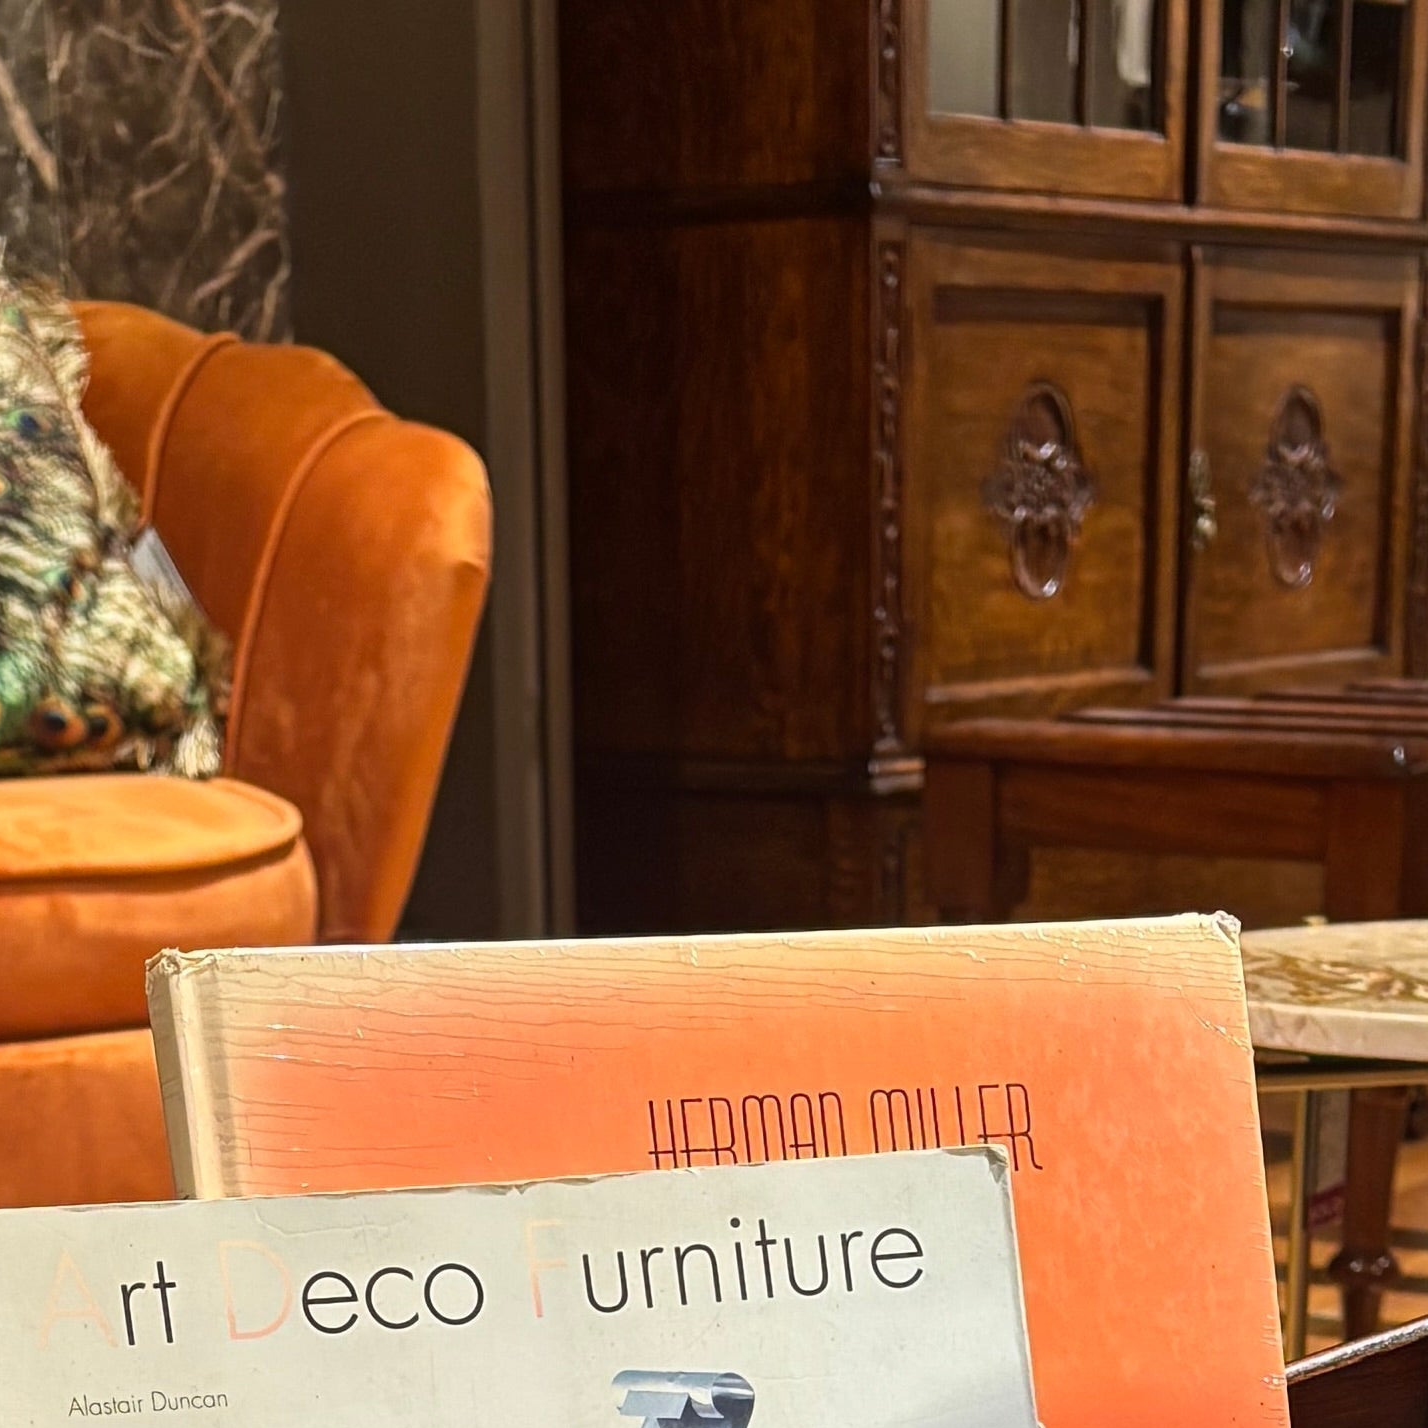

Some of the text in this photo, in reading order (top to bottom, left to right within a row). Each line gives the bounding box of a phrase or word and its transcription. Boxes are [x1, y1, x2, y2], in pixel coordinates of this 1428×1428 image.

[648, 1083, 1044, 1172] HERMAN MILLER
[37, 1216, 924, 1349] Art Deco Furniture
[68, 1390, 229, 1417] Alastair Duncan
